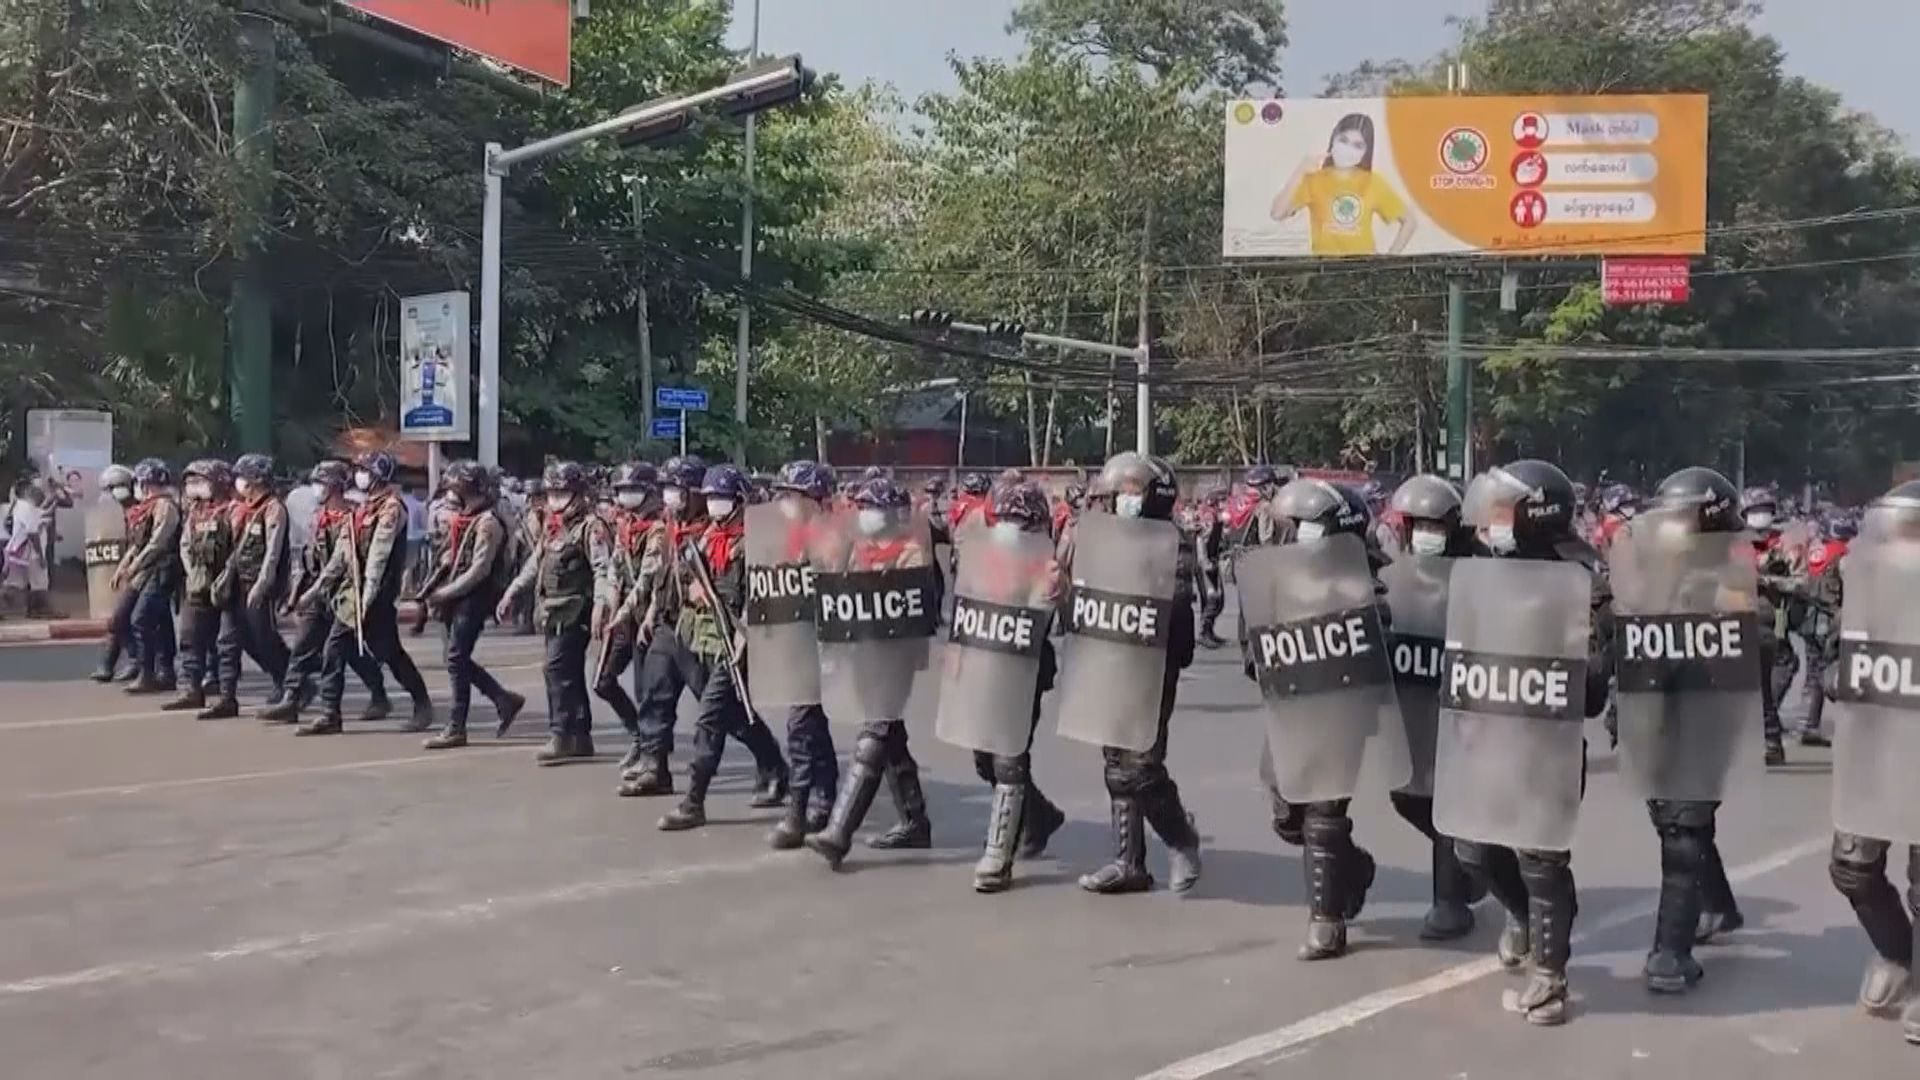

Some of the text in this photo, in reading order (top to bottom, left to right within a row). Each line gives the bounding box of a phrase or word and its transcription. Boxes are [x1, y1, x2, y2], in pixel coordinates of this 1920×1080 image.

[1566, 121, 1605, 136] Mask
[1432, 177, 1454, 188] STOP
[1528, 503, 1561, 518] POLICE
[750, 566, 817, 600] POLICE
[821, 588, 924, 622] POLICE
[1073, 598, 1157, 636] POLICE
[954, 609, 1034, 647] POLICE
[1259, 617, 1371, 668] POLICE
[1625, 620, 1743, 660] POLICE
[1394, 643, 1445, 678] OLI
[1451, 662, 1569, 706] POLICE
